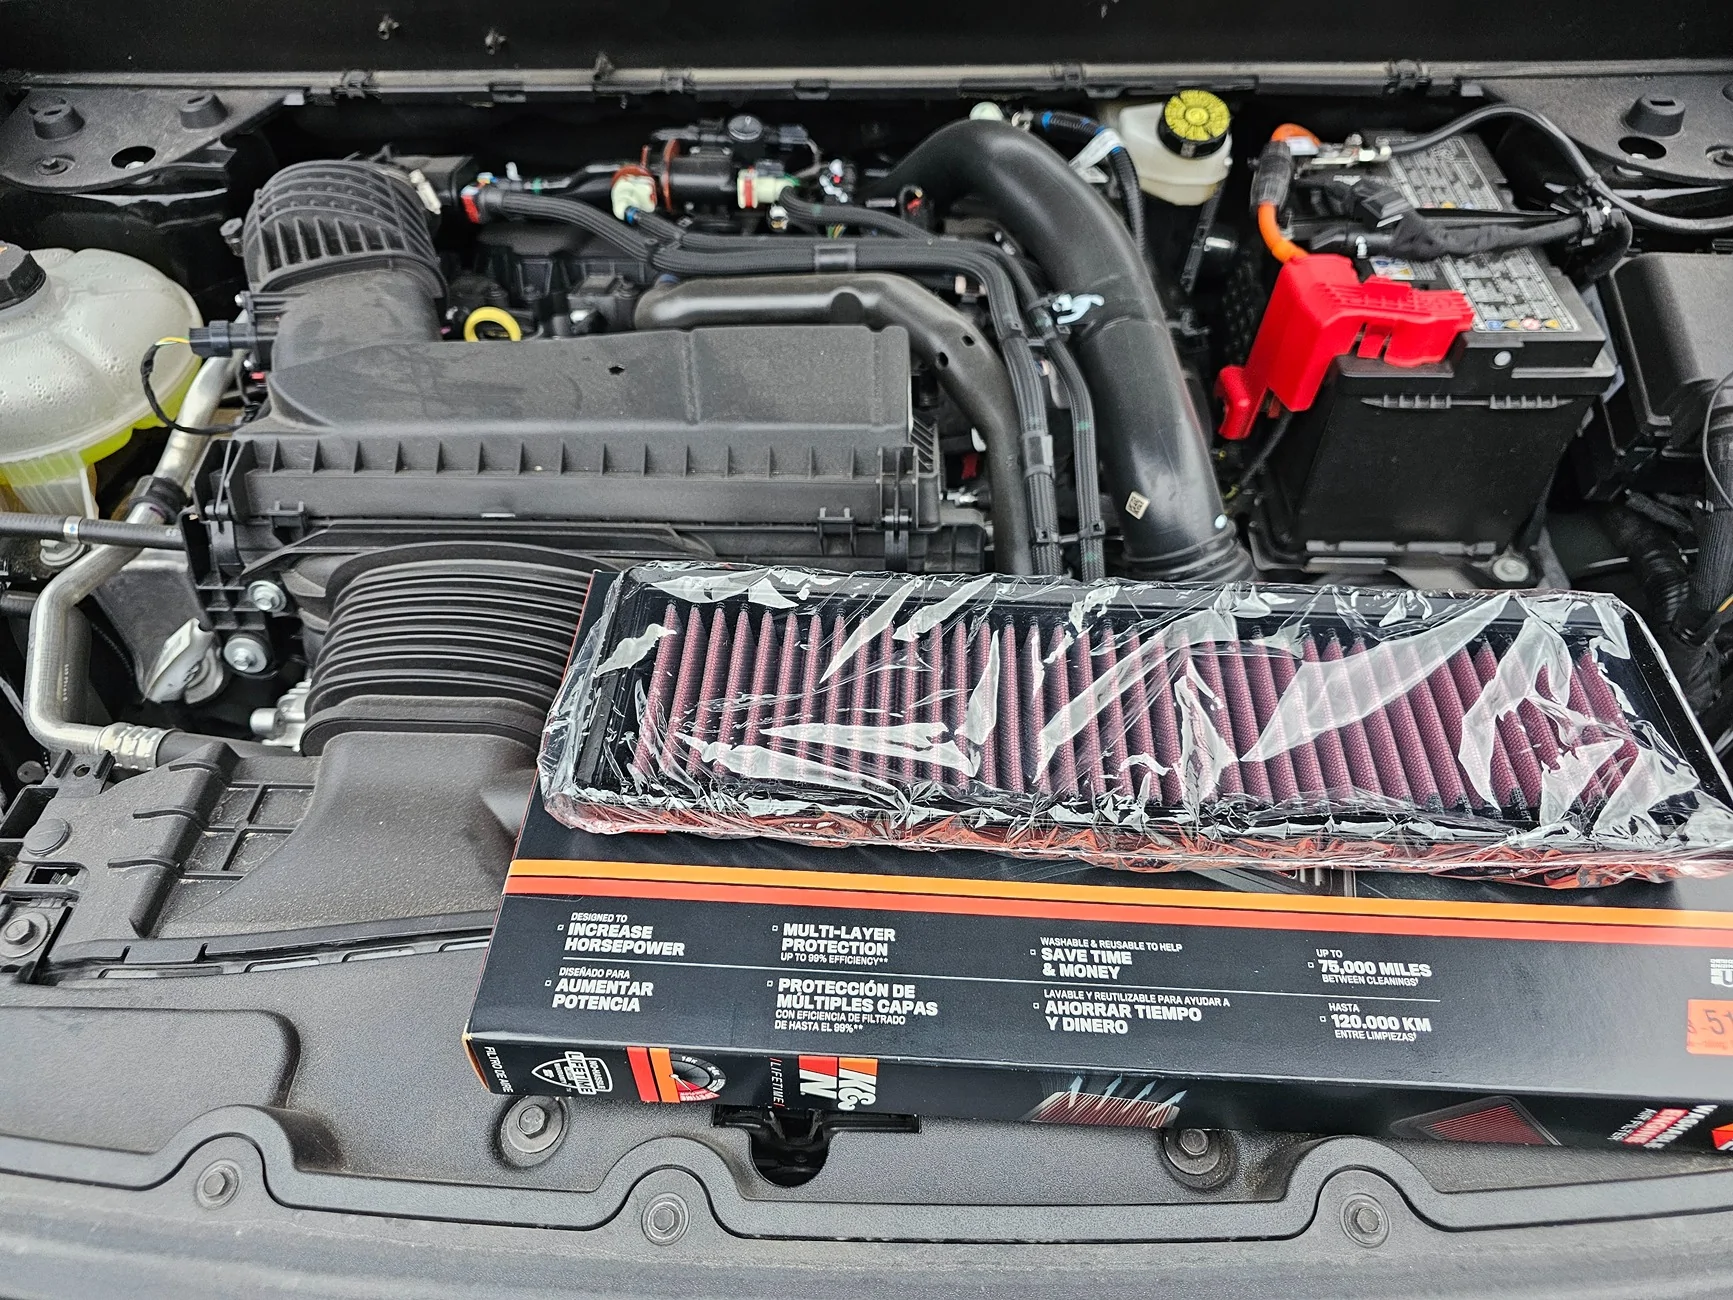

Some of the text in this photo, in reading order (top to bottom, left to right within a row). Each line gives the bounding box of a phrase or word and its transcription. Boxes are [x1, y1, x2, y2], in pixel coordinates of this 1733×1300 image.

[571, 912, 628, 923] DESIGNED TO
[567, 922, 654, 939] INCREASE
[783, 923, 896, 942] MULTI-LAYER
[564, 937, 686, 956] HORSEPOWER
[781, 938, 888, 956] PROTECTION
[1040, 937, 1183, 952] WASHABLE & REUSABLE TO HELP
[1316, 949, 1343, 958] UP TO
[780, 952, 793, 961] UP
[795, 953, 807, 962] TO
[808, 954, 827, 964] 99%
[1041, 948, 1133, 965] SAVE TIME
[559, 966, 630, 979] DISEÑADO PARA
[1042, 963, 1121, 980] & MONEY
[1318, 959, 1433, 977] 75,000 MILES
[555, 978, 654, 996] AUMENTAR
[778, 978, 915, 999] PROTECCIÓN DE
[1322, 974, 1365, 985] BETWEEN
[552, 993, 641, 1012] POTENCIA
[776, 991, 939, 1016] MÚLTIPLES CAPAS
[1043, 989, 1231, 1007] LAVABLE Y REUTILIZABLE PARA AYUDAR A
[775, 1009, 906, 1025] CON EFICIENCIA DE FILTRADO
[1045, 1000, 1202, 1021] AHORRAR TIEMPO
[1328, 1003, 1360, 1013] HASTA
[774, 1020, 788, 1030] DE
[788, 1021, 820, 1032] HASTA
[821, 1022, 832, 1032] EL
[1045, 1016, 1129, 1034] Y DINERO
[1331, 1014, 1432, 1032] 120.000 KM
[1334, 1029, 1365, 1040] ENTRE
[484, 1046, 514, 1093] FILTRO DE AIRE
[567, 1053, 594, 1093] LIFETIME
